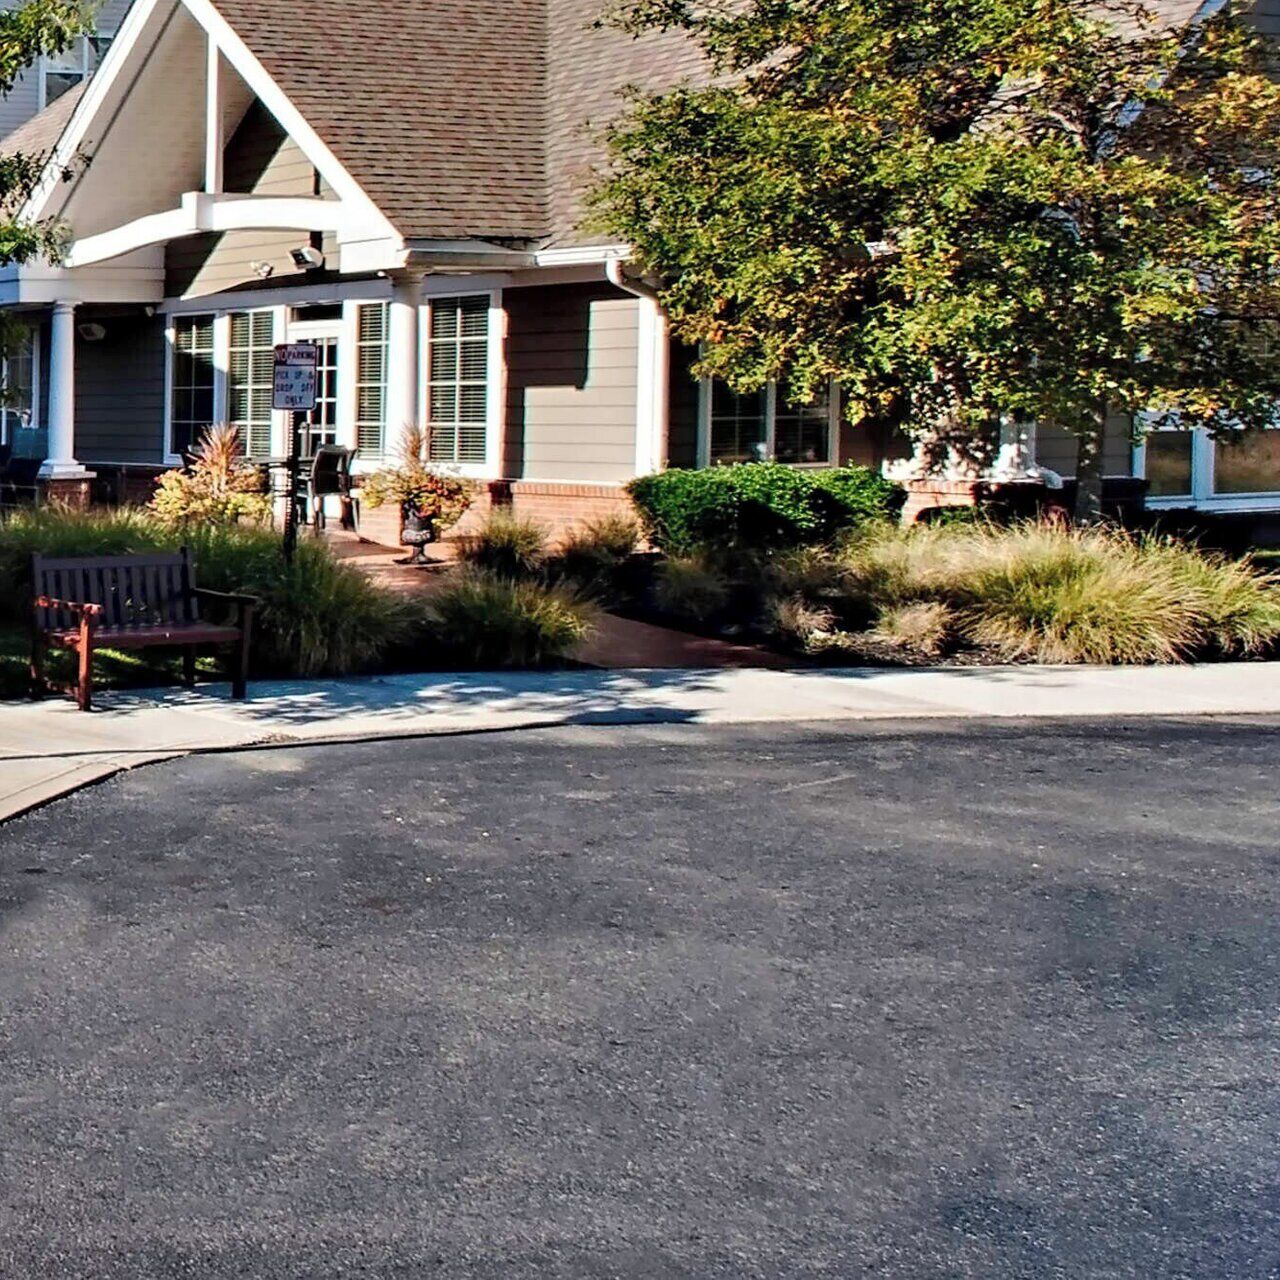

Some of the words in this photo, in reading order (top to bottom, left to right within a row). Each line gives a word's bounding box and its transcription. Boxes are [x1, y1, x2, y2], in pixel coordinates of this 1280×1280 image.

[274, 349, 287, 361] NO
[287, 351, 315, 359] PARKING
[285, 395, 303, 405] ONLY
